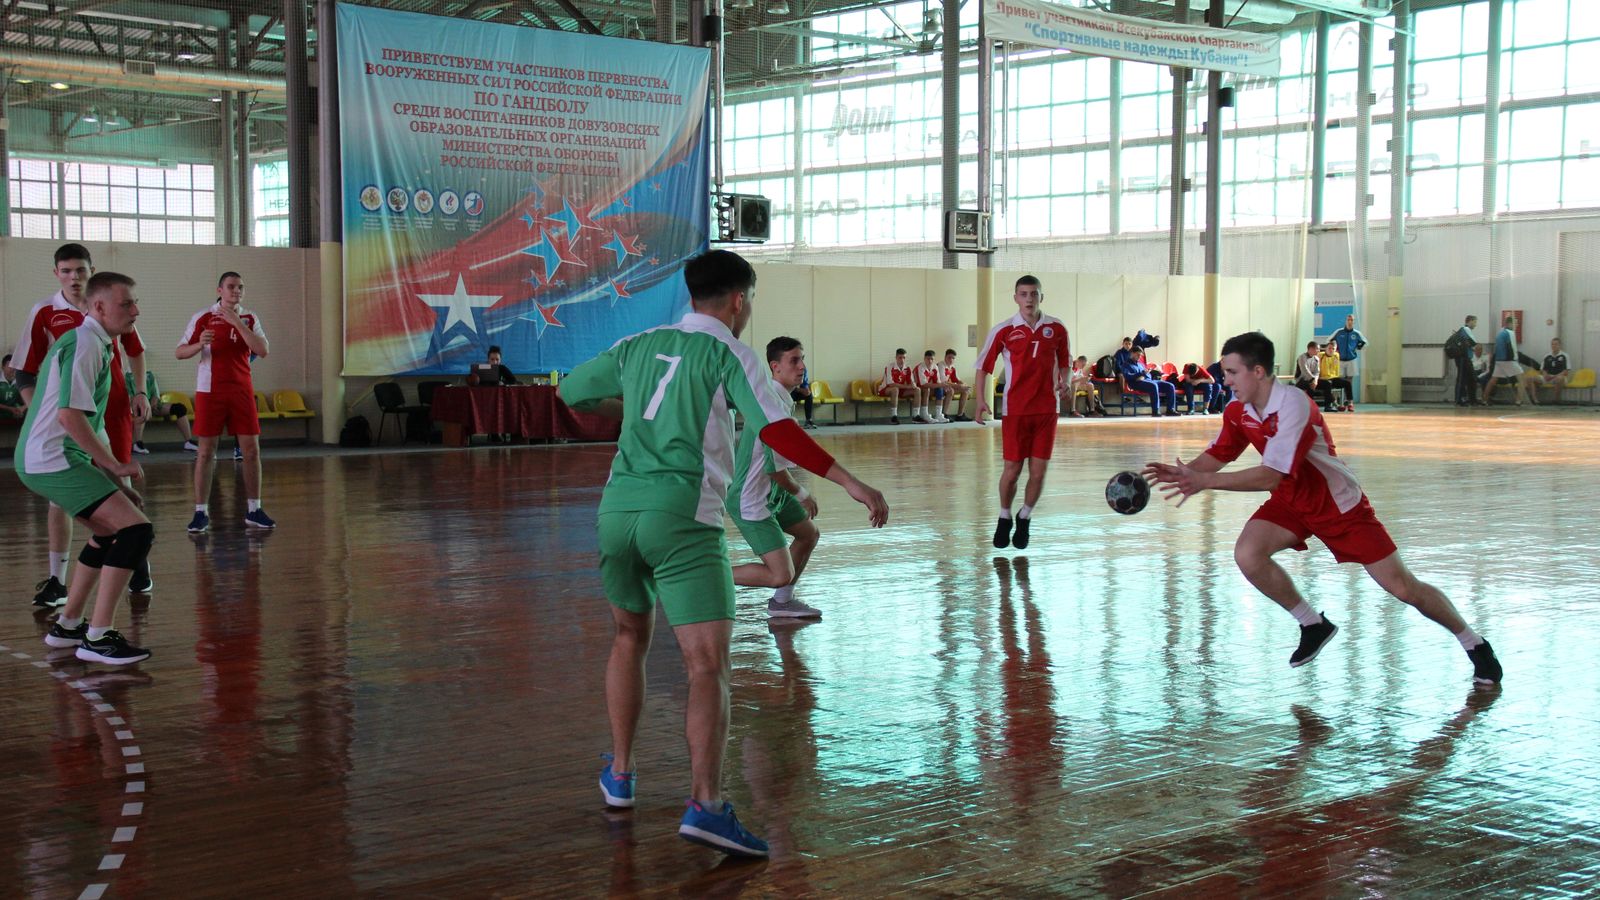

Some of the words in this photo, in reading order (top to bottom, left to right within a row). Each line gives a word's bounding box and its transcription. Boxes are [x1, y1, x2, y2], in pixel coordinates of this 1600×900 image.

[996, 1, 1041, 20] Привет
[1043, 10, 1114, 31] участникам
[1116, 21, 1197, 44] Всекубанской
[1123, 41, 1188, 60] надежды
[382, 48, 494, 71] ПРИВЕТСТВУЕМ
[496, 60, 585, 81] УЧАСТНИКОВ
[588, 70, 669, 89] ПЕРВЕНСТВА
[364, 62, 480, 86] ВООРУЖЕННЫХ
[482, 75, 511, 89] СИЛ
[514, 78, 602, 98] РОССИЙСКОЙ
[604, 88, 682, 106] ФЕДЕРАЦИИ
[474, 91, 499, 106] ПО
[502, 94, 589, 114] ГАНДБОЛУ
[393, 102, 440, 118] СРЕДИ
[443, 107, 565, 128] ВОСПИТАННИКОВ
[568, 118, 660, 136] ДОВУЗОВСКИХ
[409, 120, 547, 142] ОБРАЗОВАТЕЛЬНЫХ
[550, 131, 647, 150] ОРГАНИЗАЦИЙ
[439, 154, 533, 172] РОССИЙСКОЙ
[442, 138, 552, 158] МИНИСТЕРСТВА
[554, 147, 618, 163] ОБОРОНЫ
[230, 327, 238, 343] 4
[1031, 340, 1039, 358] 7
[643, 353, 682, 421] 7
